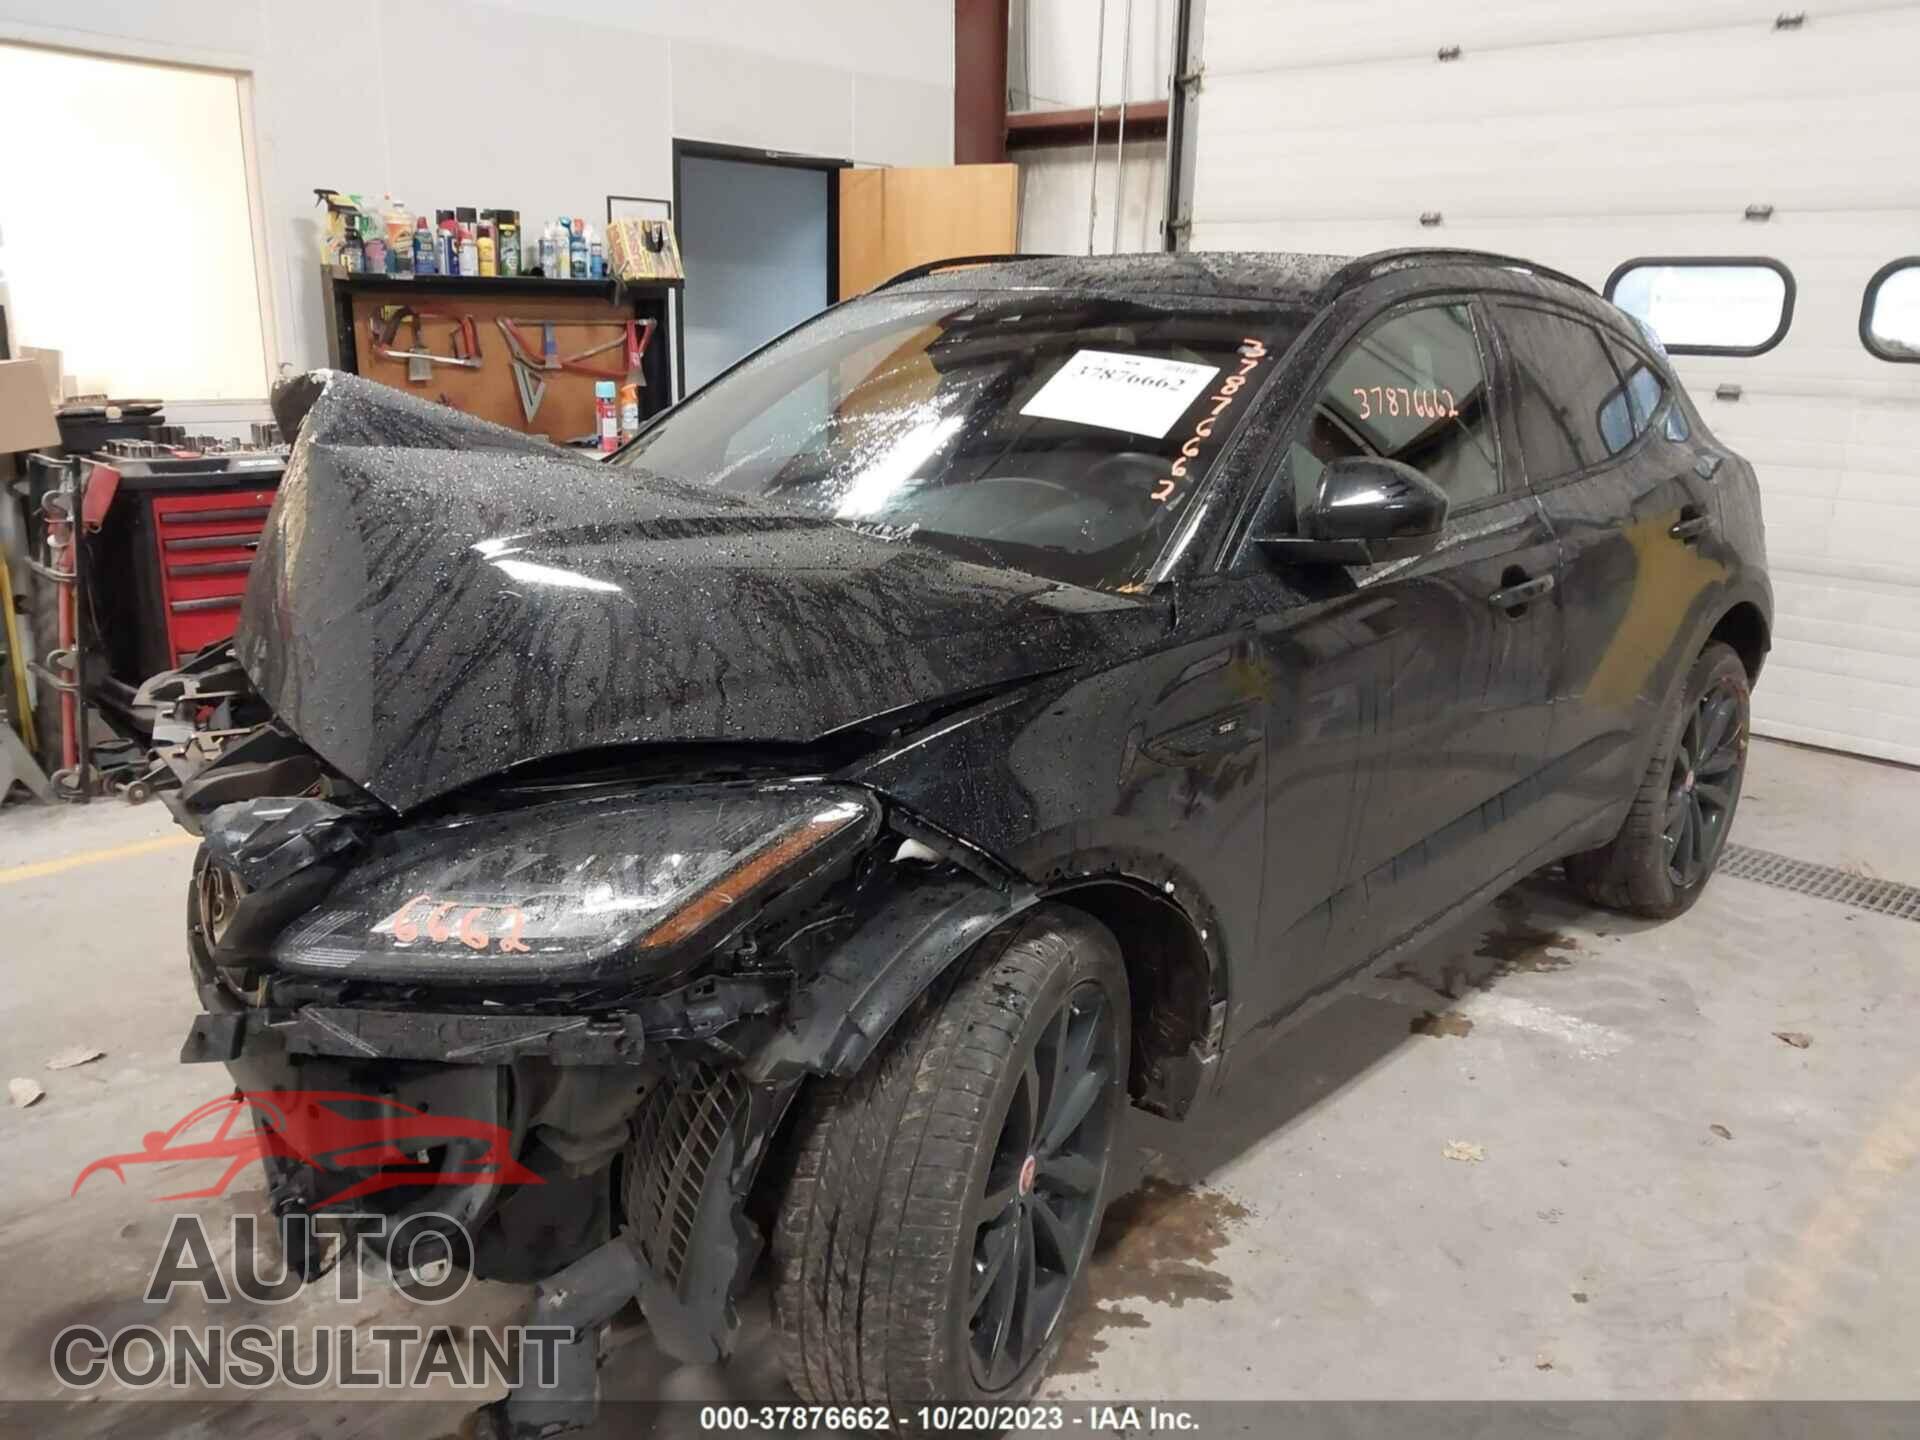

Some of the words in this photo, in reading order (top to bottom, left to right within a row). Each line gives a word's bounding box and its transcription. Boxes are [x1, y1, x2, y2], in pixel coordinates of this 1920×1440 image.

[1151, 338, 1267, 502] 37876662
[1353, 386, 1459, 420] 37876662
[394, 894, 531, 953] 6662
